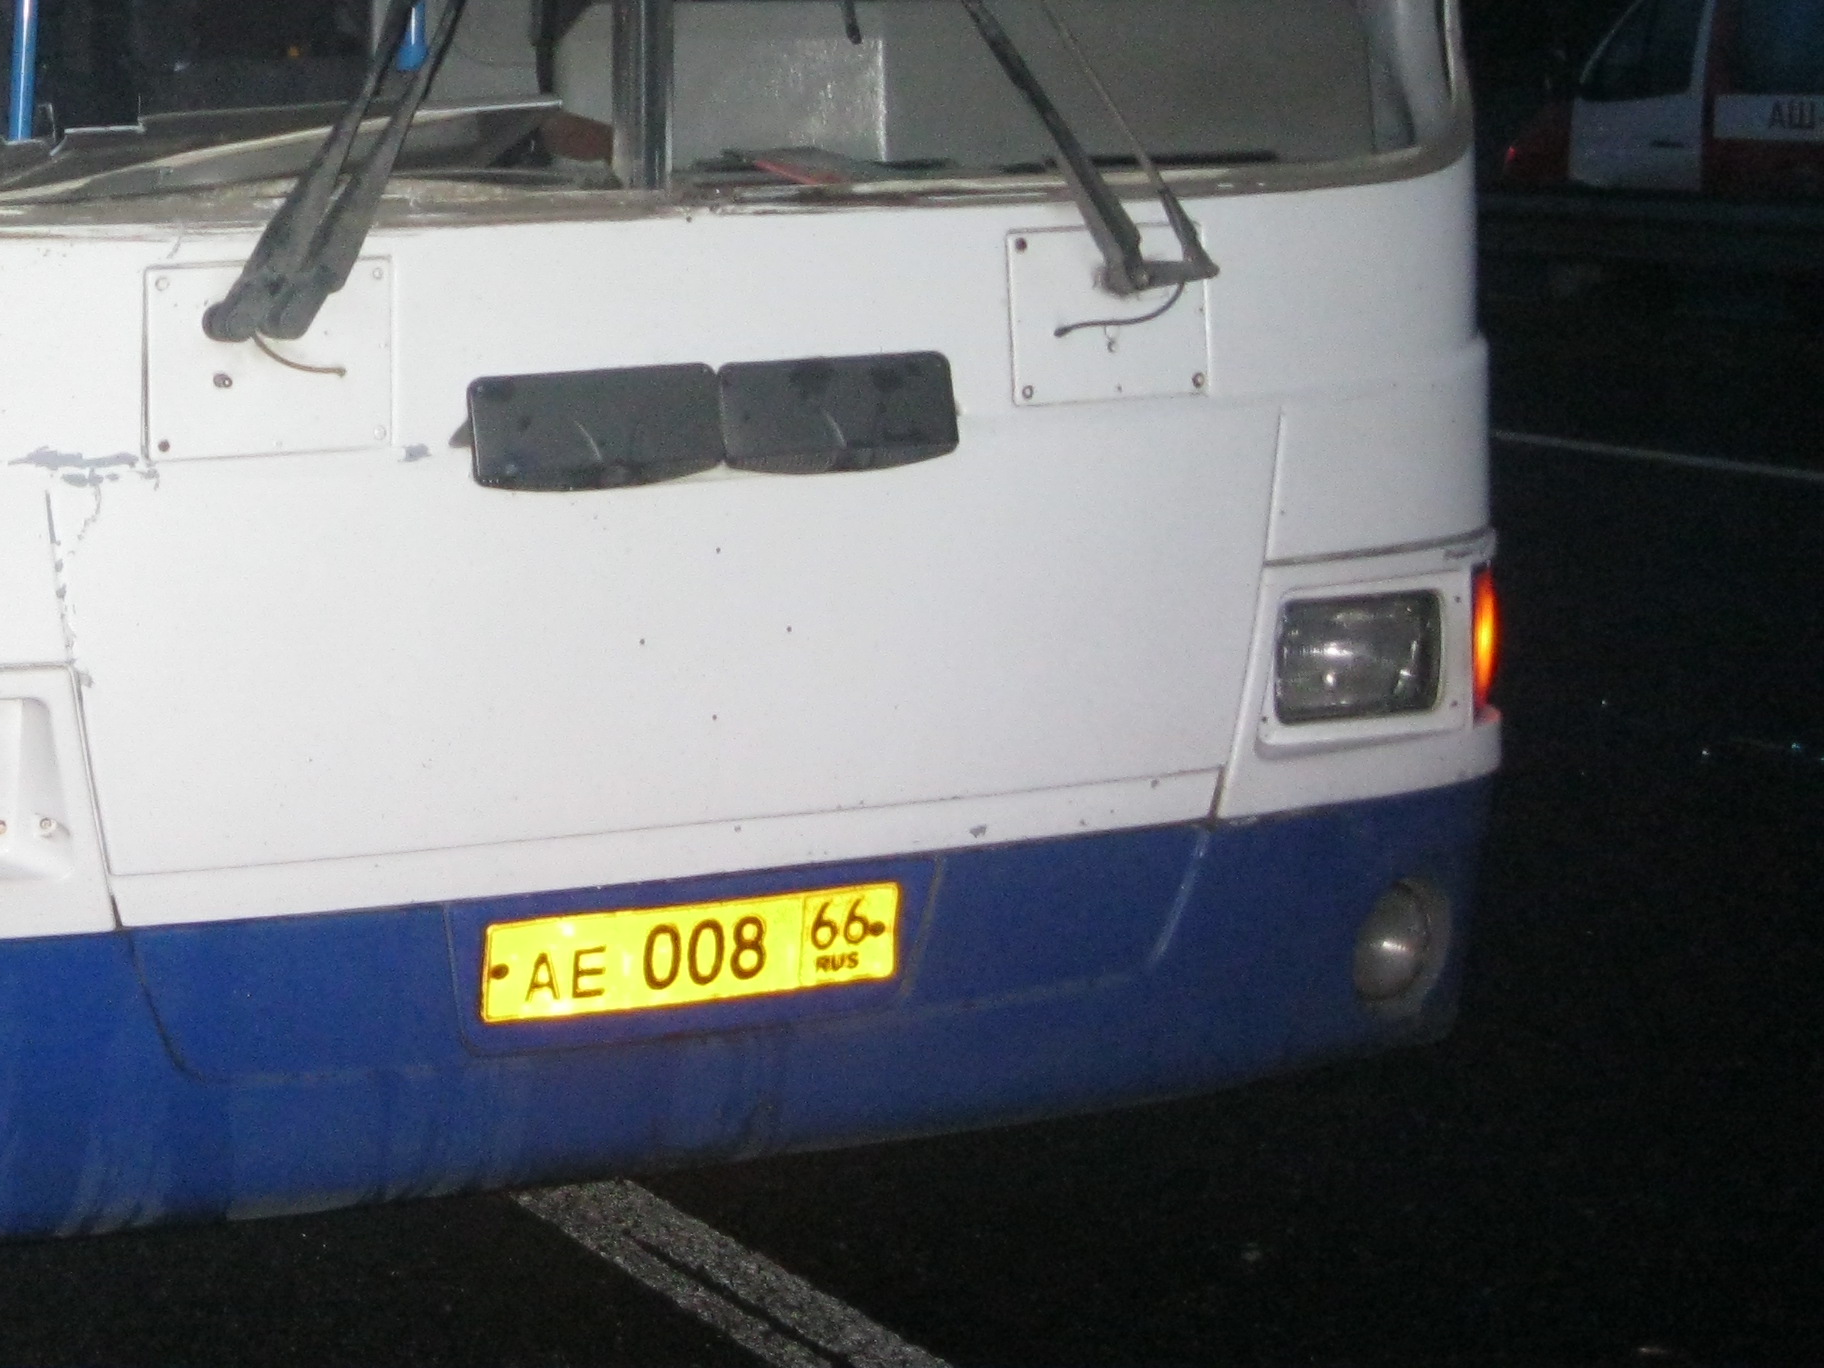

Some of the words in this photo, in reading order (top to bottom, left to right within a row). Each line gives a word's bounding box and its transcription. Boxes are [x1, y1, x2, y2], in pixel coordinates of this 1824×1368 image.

[643, 915, 768, 991] 008
[811, 898, 870, 950] 66
[814, 950, 860, 973] RUS
